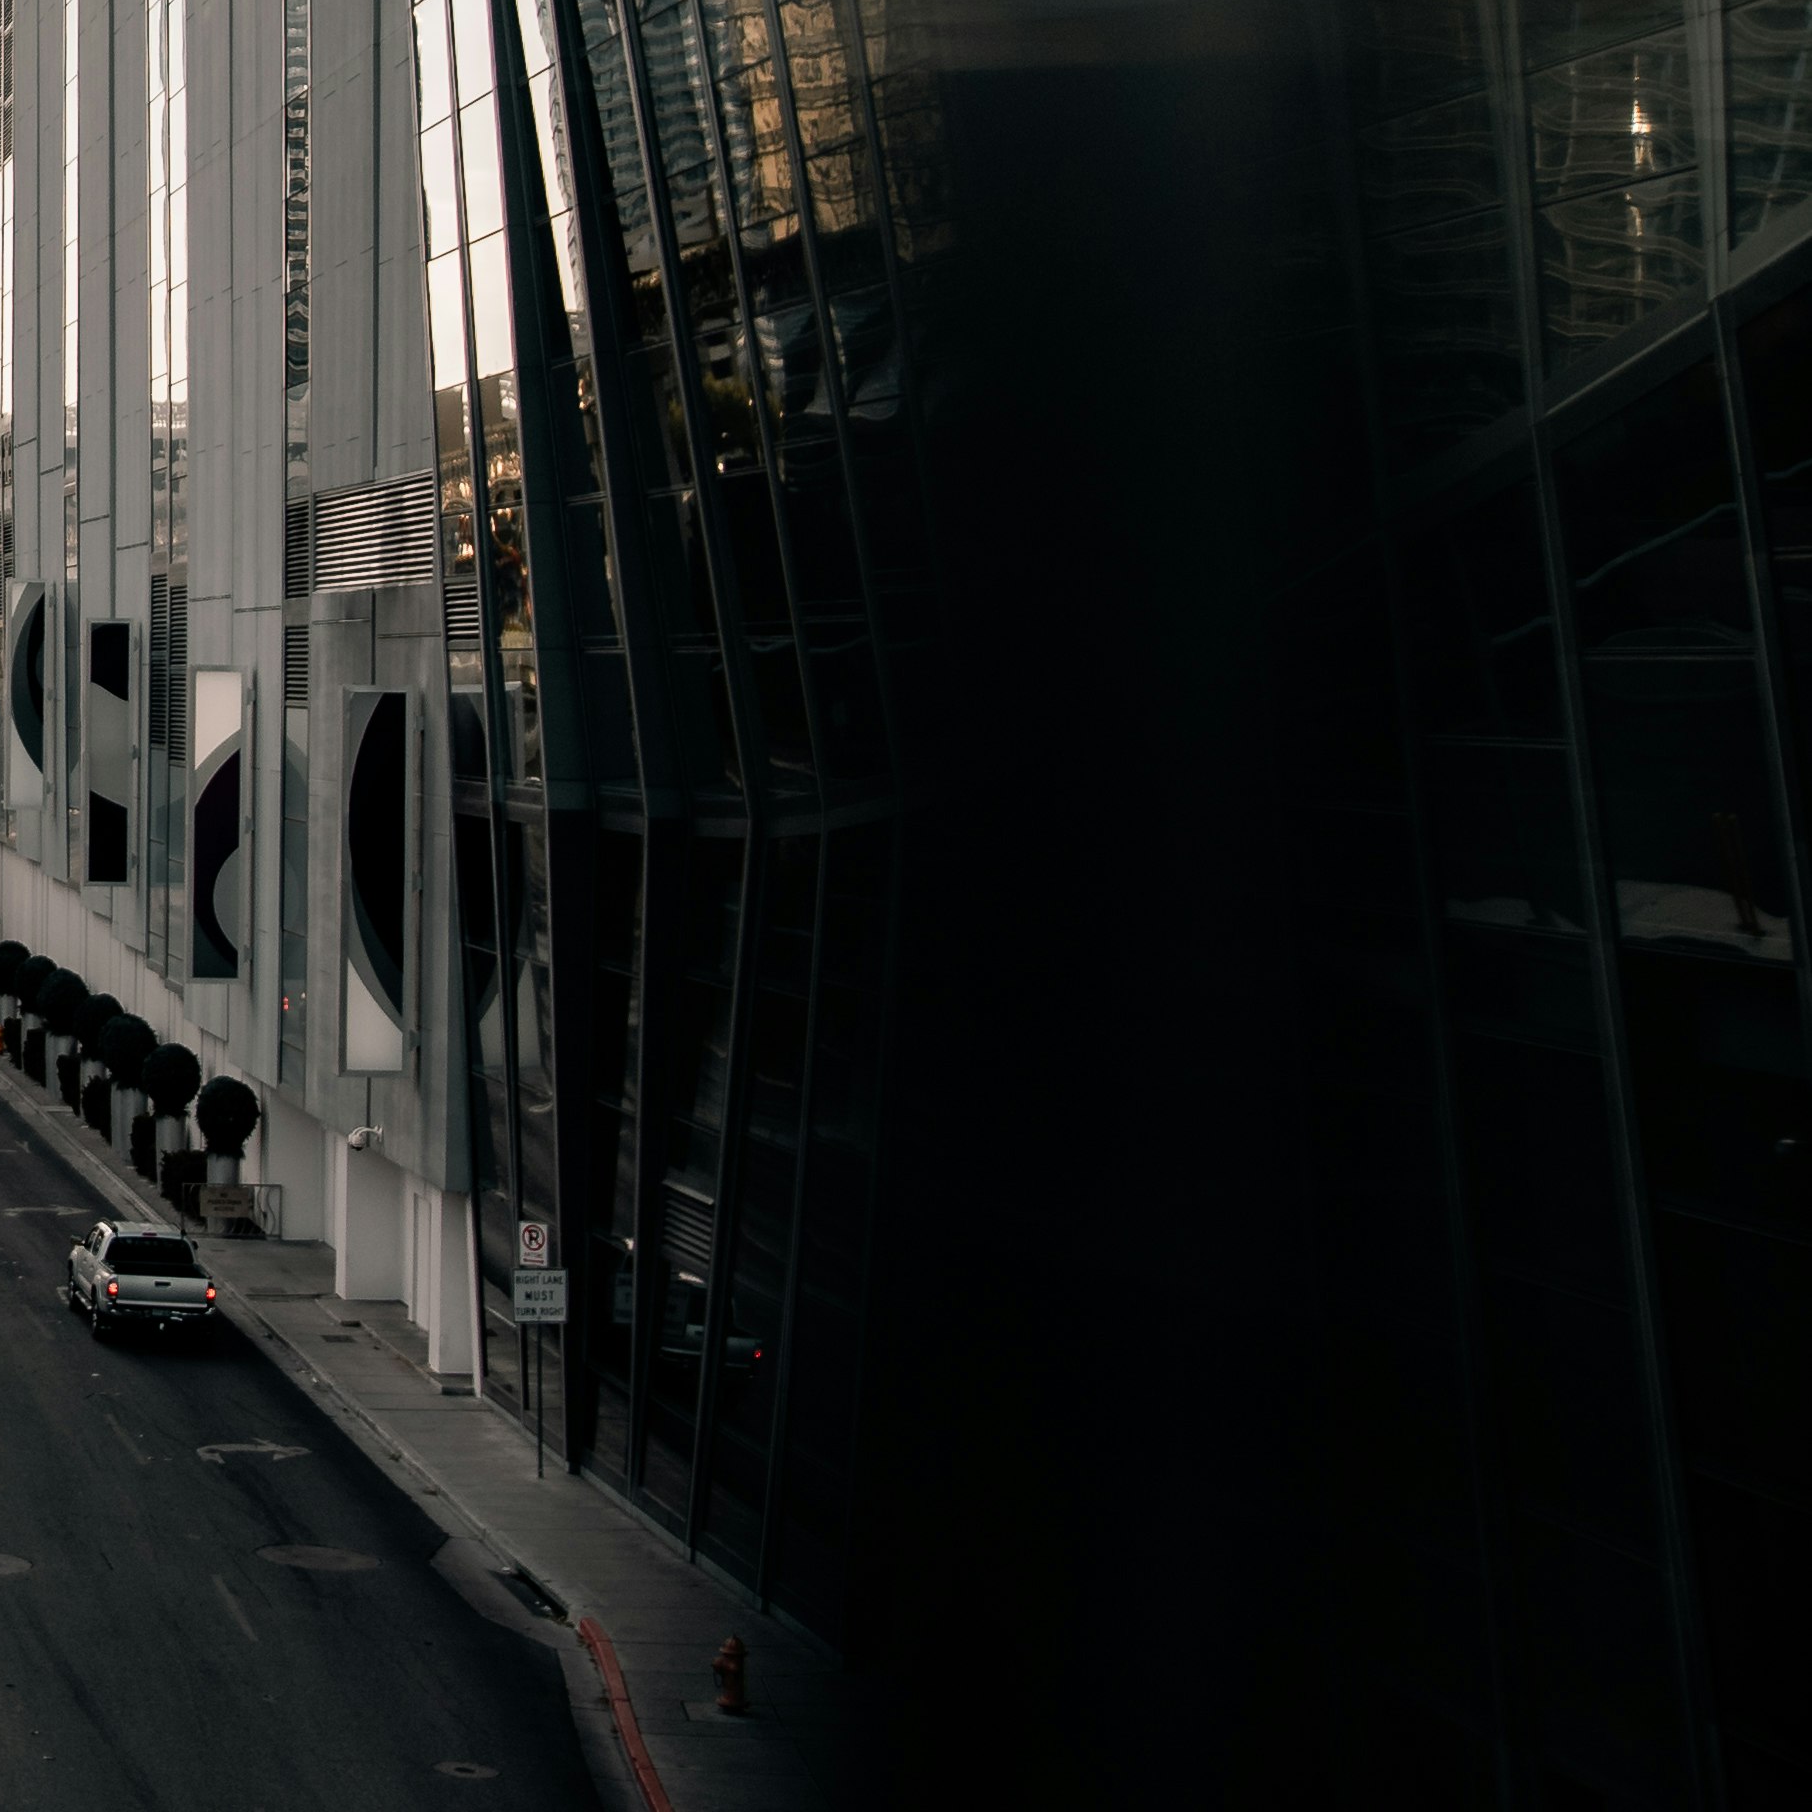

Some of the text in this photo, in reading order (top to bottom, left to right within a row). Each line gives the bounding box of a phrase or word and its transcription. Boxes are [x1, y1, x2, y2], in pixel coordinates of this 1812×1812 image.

[516, 1275, 563, 1285] RIGHT LANE
[525, 1291, 554, 1301] MUST
[516, 1307, 563, 1316] TURN RIGHT
